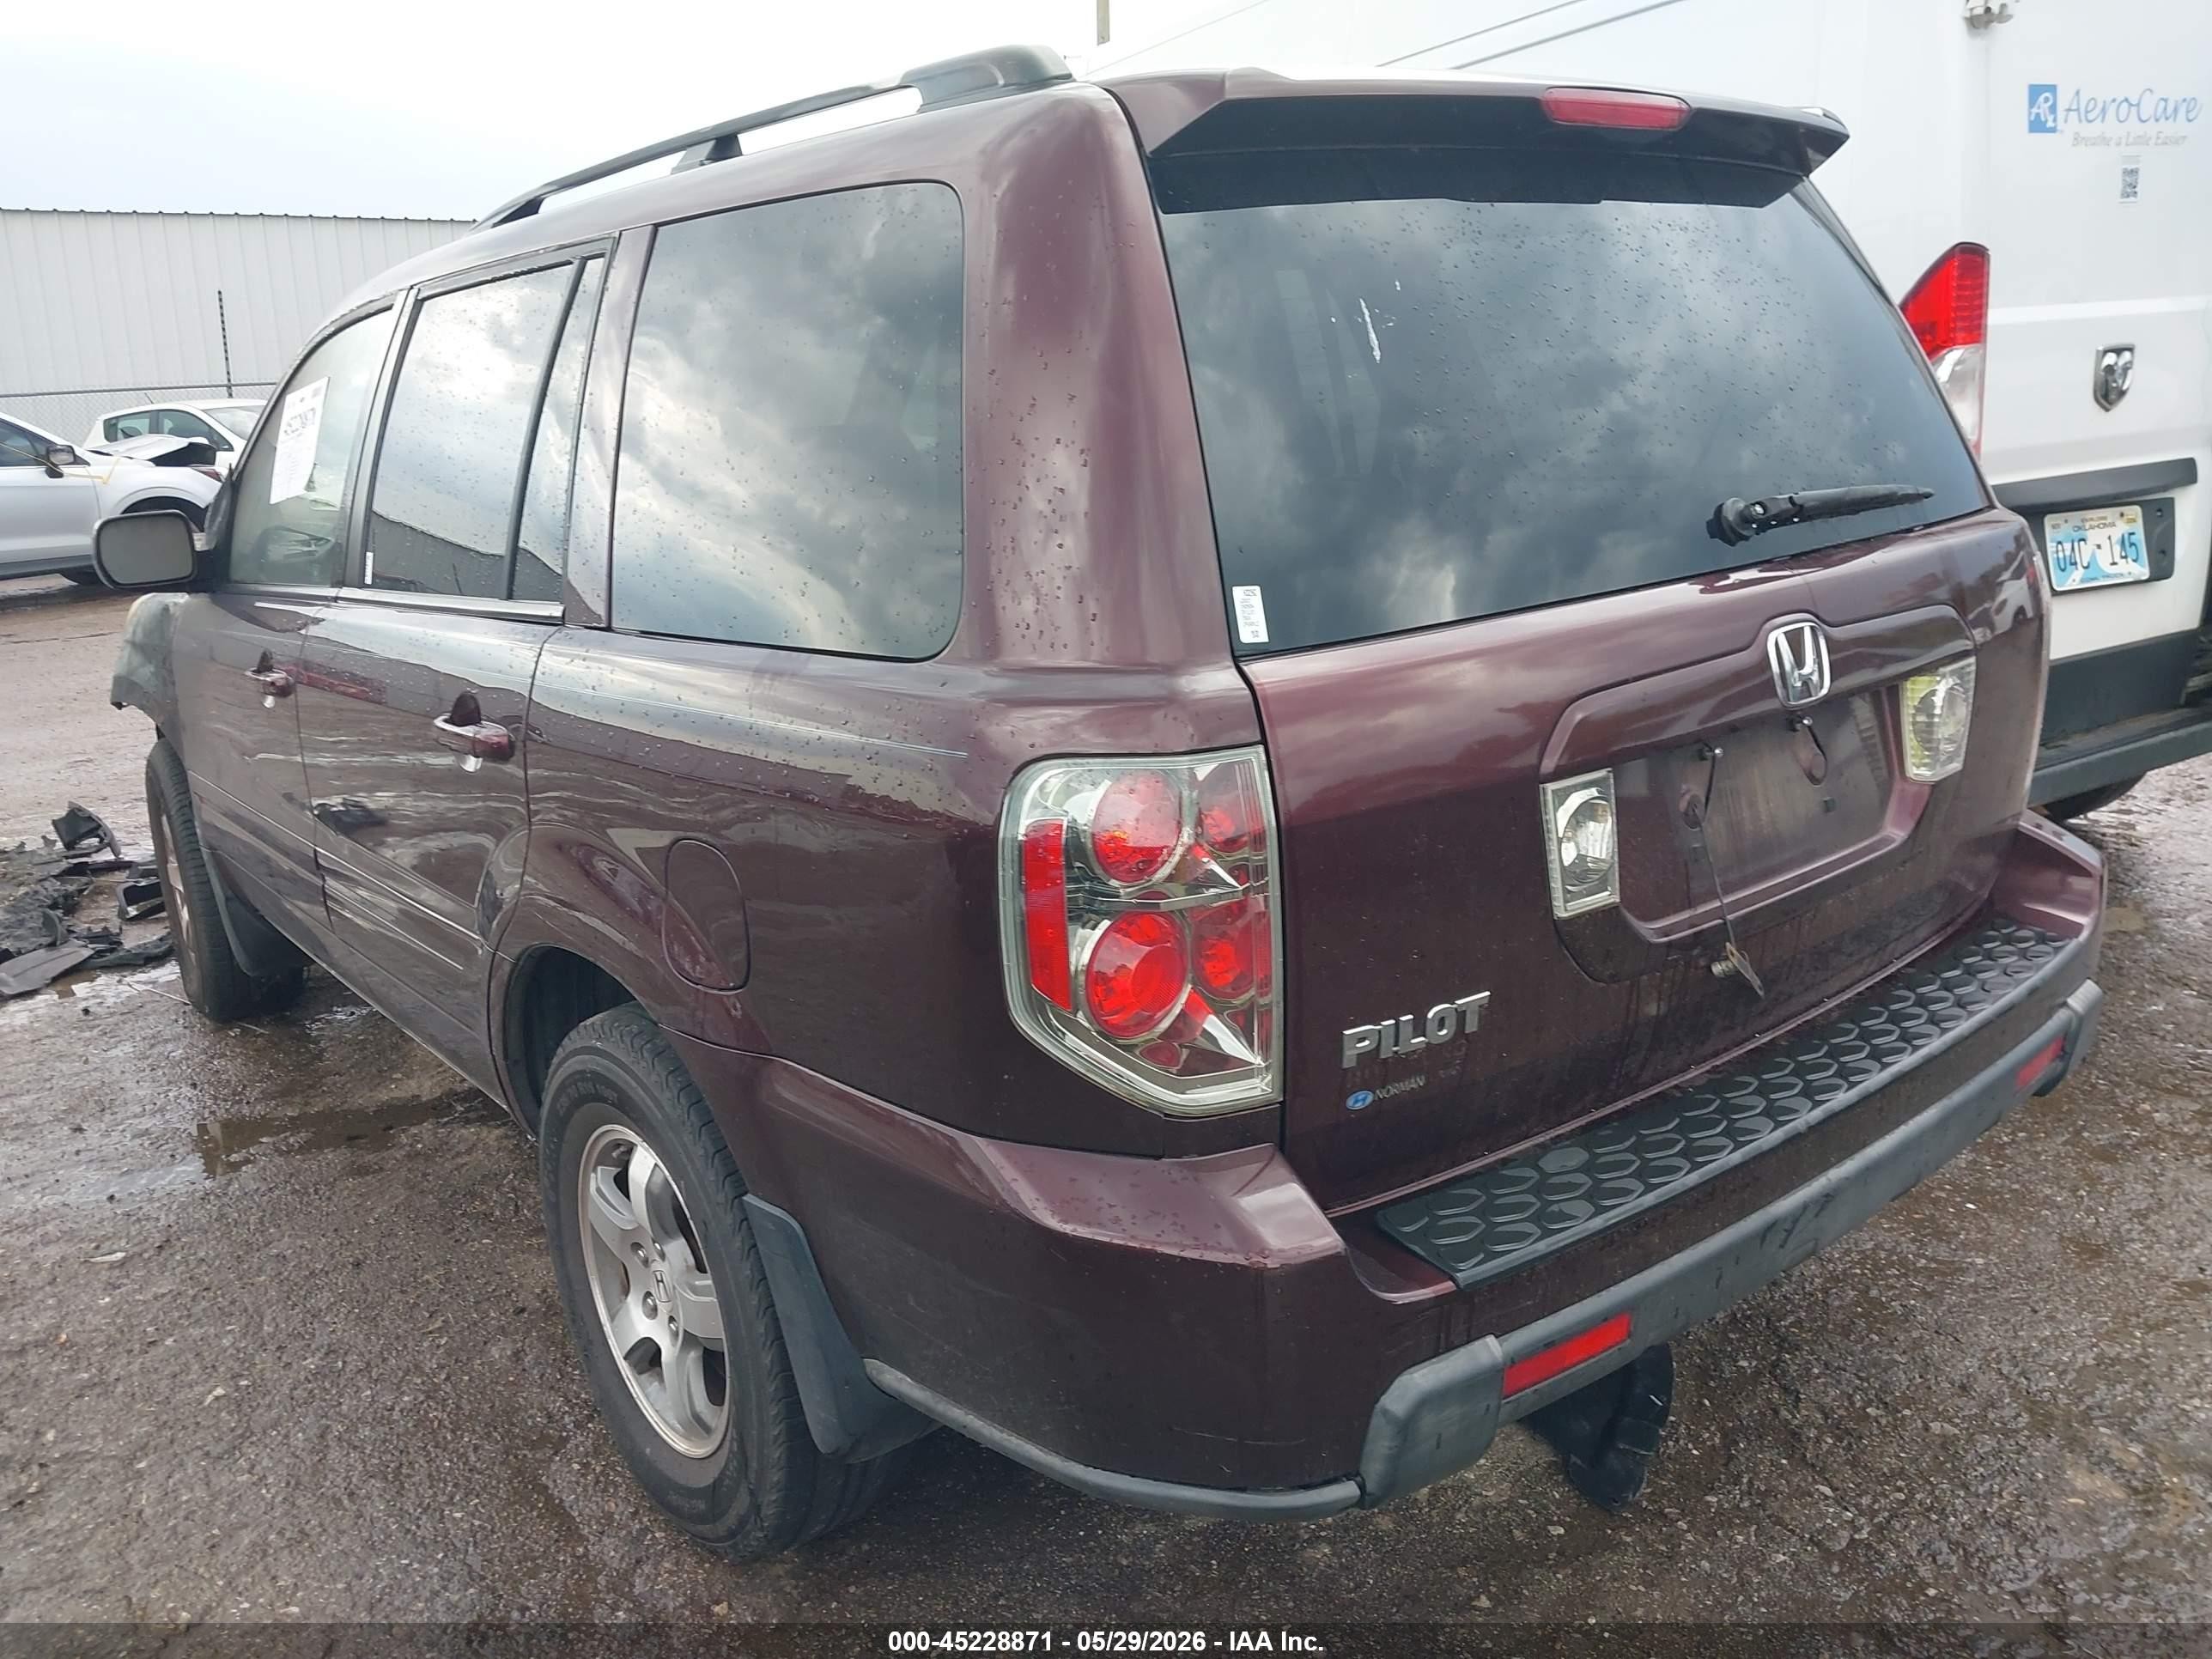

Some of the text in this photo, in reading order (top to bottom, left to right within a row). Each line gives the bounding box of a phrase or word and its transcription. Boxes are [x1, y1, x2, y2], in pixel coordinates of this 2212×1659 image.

[2063, 88, 2202, 124] AeroCare
[2071, 131, 2188, 147] Breathe a Little Easier
[2073, 521, 2117, 532] OKLAHOMA
[1341, 990, 1492, 1069] PILOT
[1376, 1075, 1426, 1099] NORMAN
